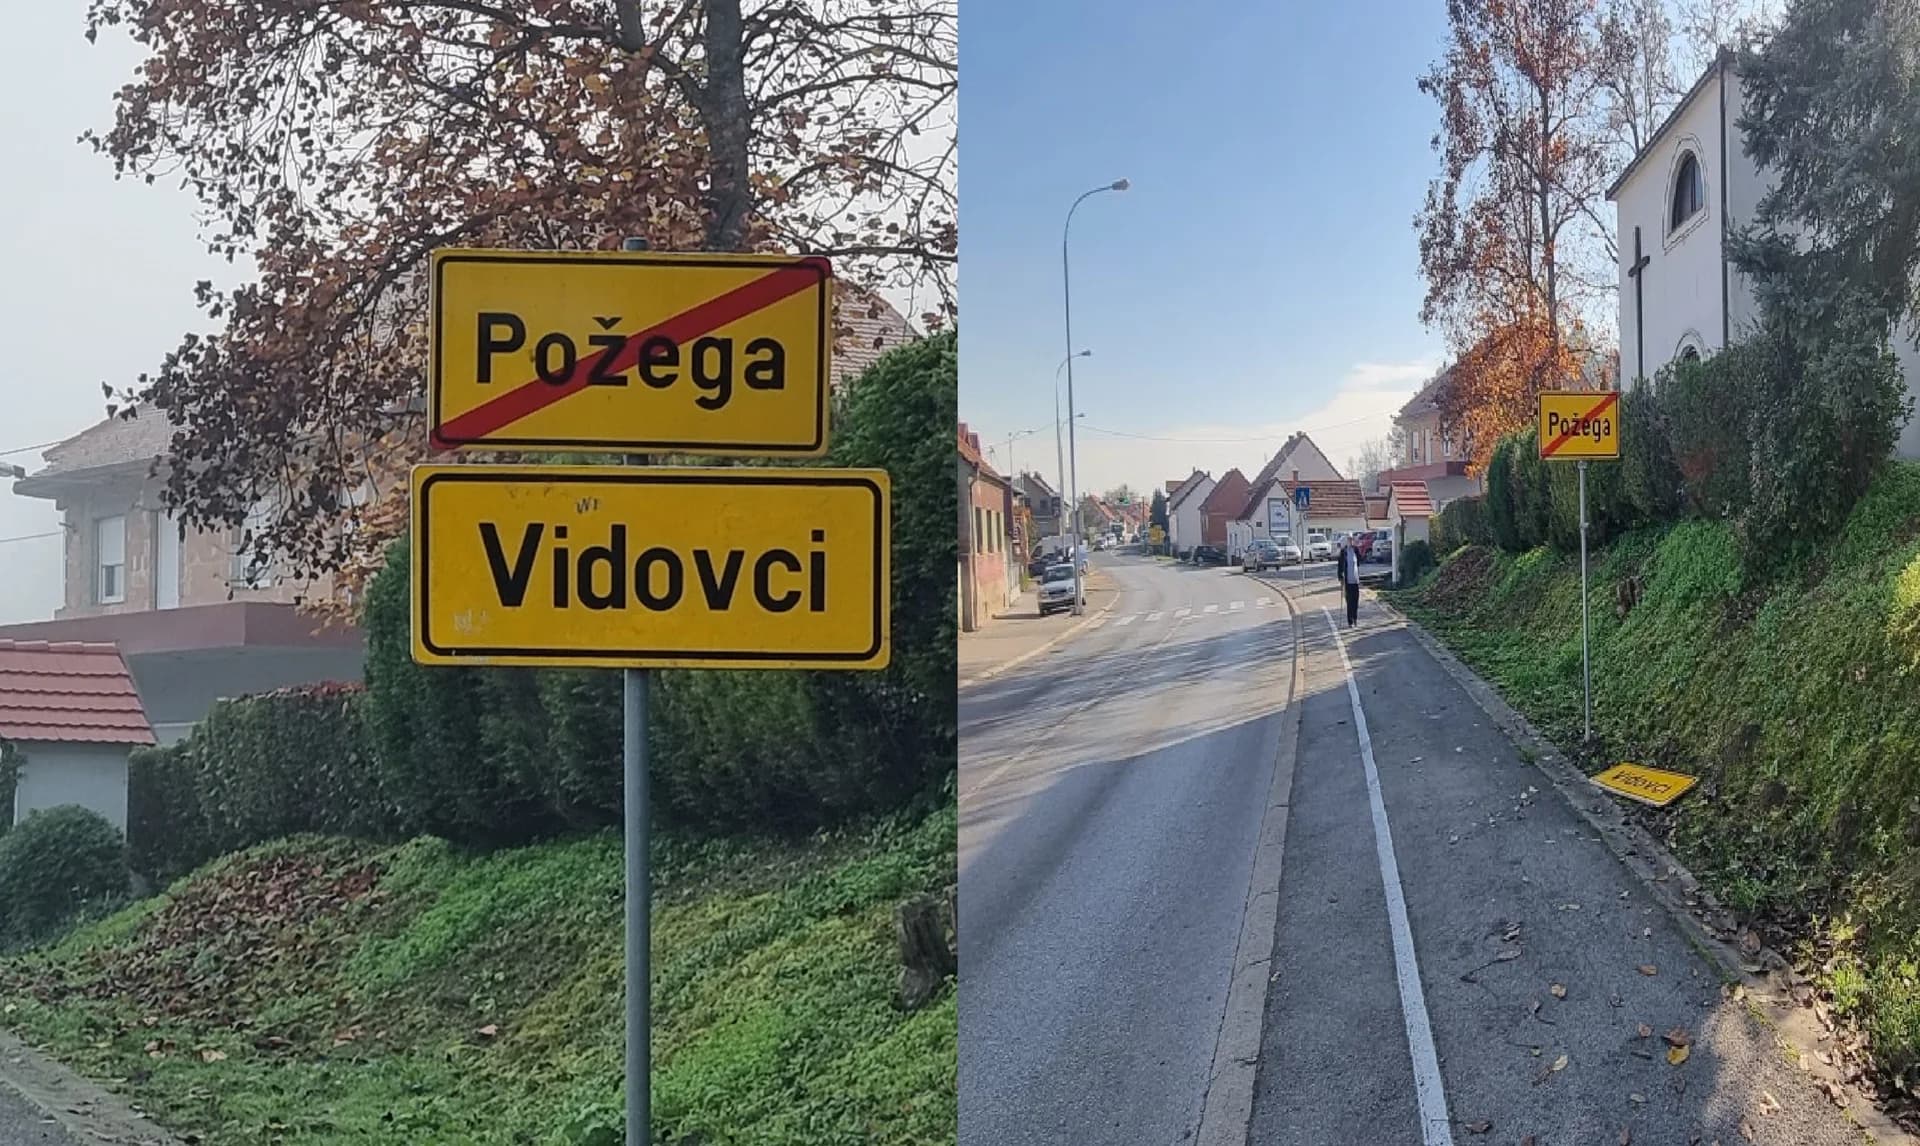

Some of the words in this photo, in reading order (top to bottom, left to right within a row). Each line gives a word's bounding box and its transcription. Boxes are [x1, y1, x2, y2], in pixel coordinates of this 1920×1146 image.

[476, 312, 785, 410] Požega
[1548, 411, 1611, 444] Požega
[478, 522, 826, 612] Vidovci
